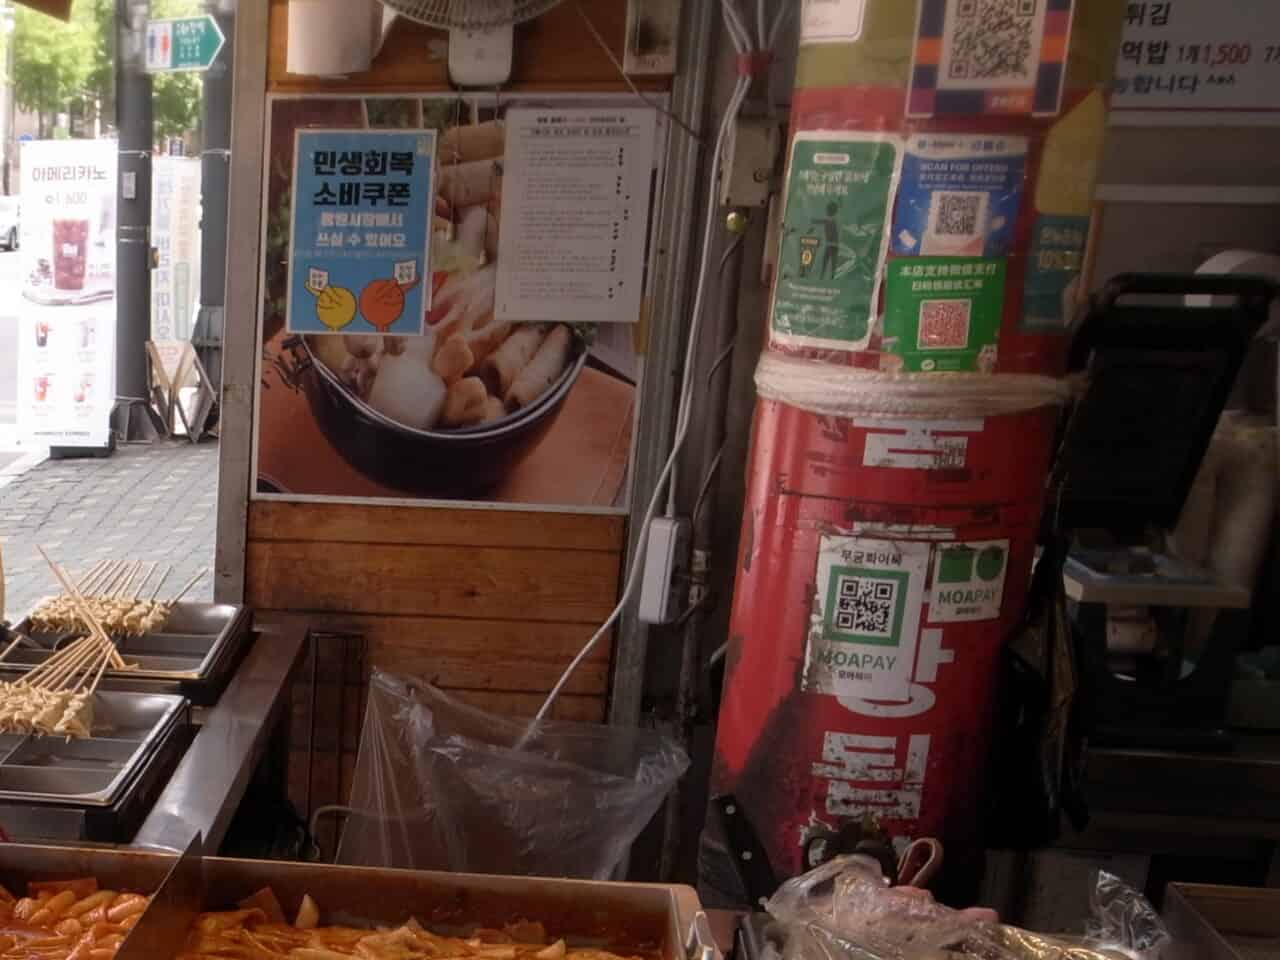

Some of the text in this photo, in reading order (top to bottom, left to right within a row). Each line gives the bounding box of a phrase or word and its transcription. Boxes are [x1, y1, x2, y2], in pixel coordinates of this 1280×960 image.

[314, 150, 415, 176] 민생회복
[32, 165, 108, 182] 아메리카노
[313, 182, 412, 206] 소비쿠폰
[316, 232, 406, 247] 쓰실 수 있어요
[938, 589, 995, 605] MOAPAY
[817, 650, 897, 671] MOAPAY
